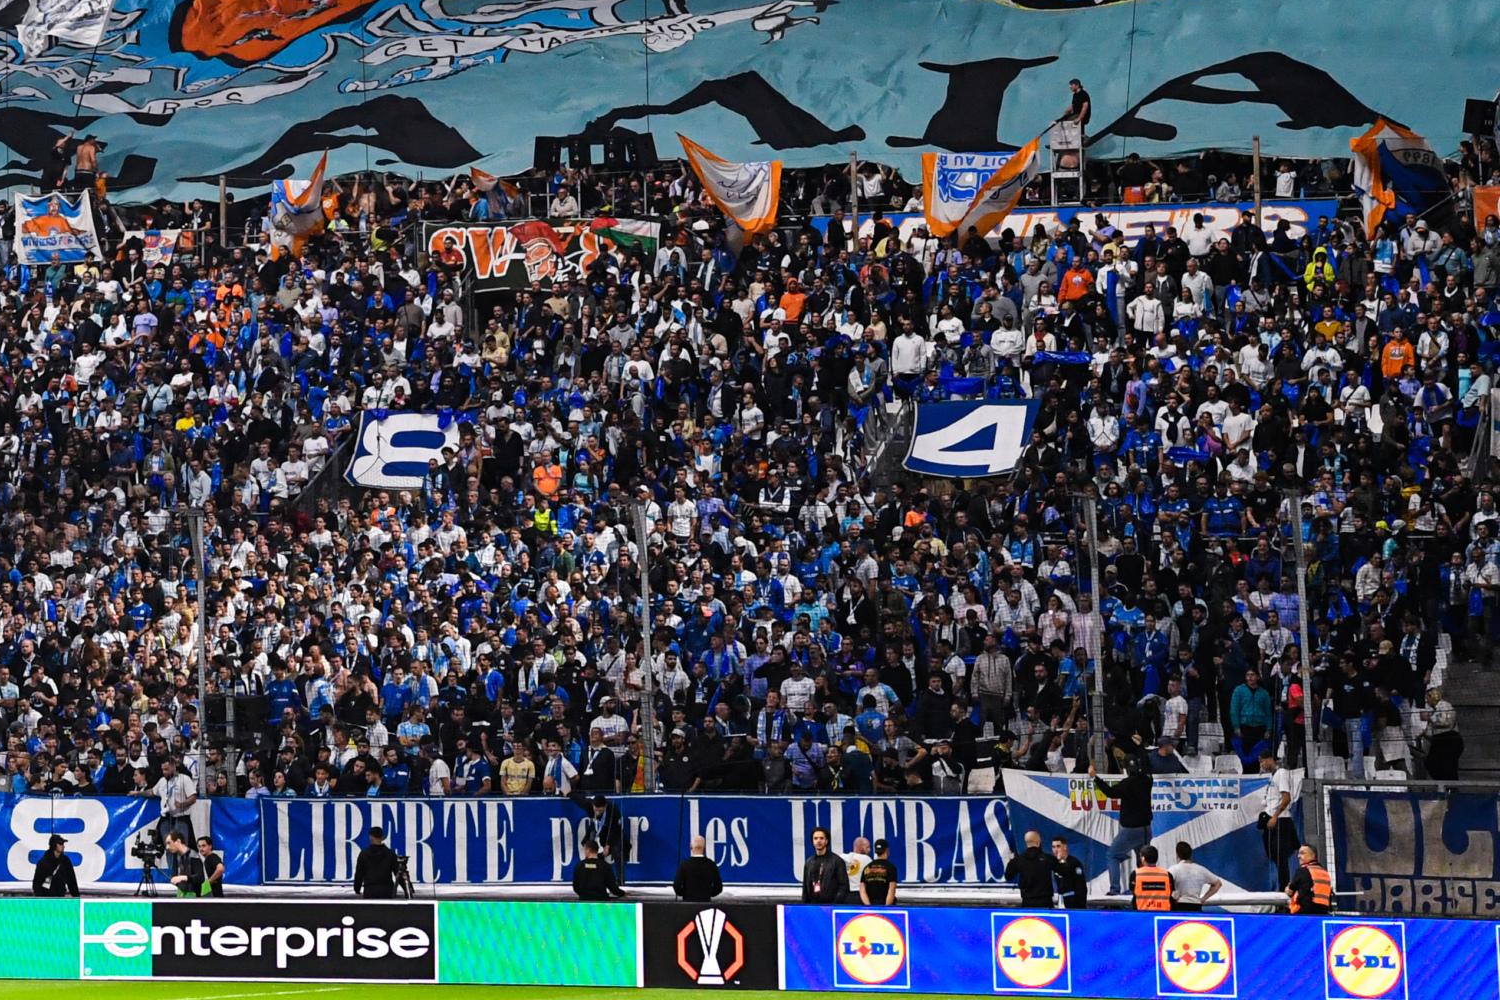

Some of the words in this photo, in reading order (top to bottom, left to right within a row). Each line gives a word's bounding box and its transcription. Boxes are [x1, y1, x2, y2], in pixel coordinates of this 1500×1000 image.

[910, 404, 1028, 474] 4
[273, 799, 515, 884] LIBERTE
[687, 798, 750, 868] les
[787, 799, 1013, 885] ULTRAS
[100, 916, 430, 970] enterprise
